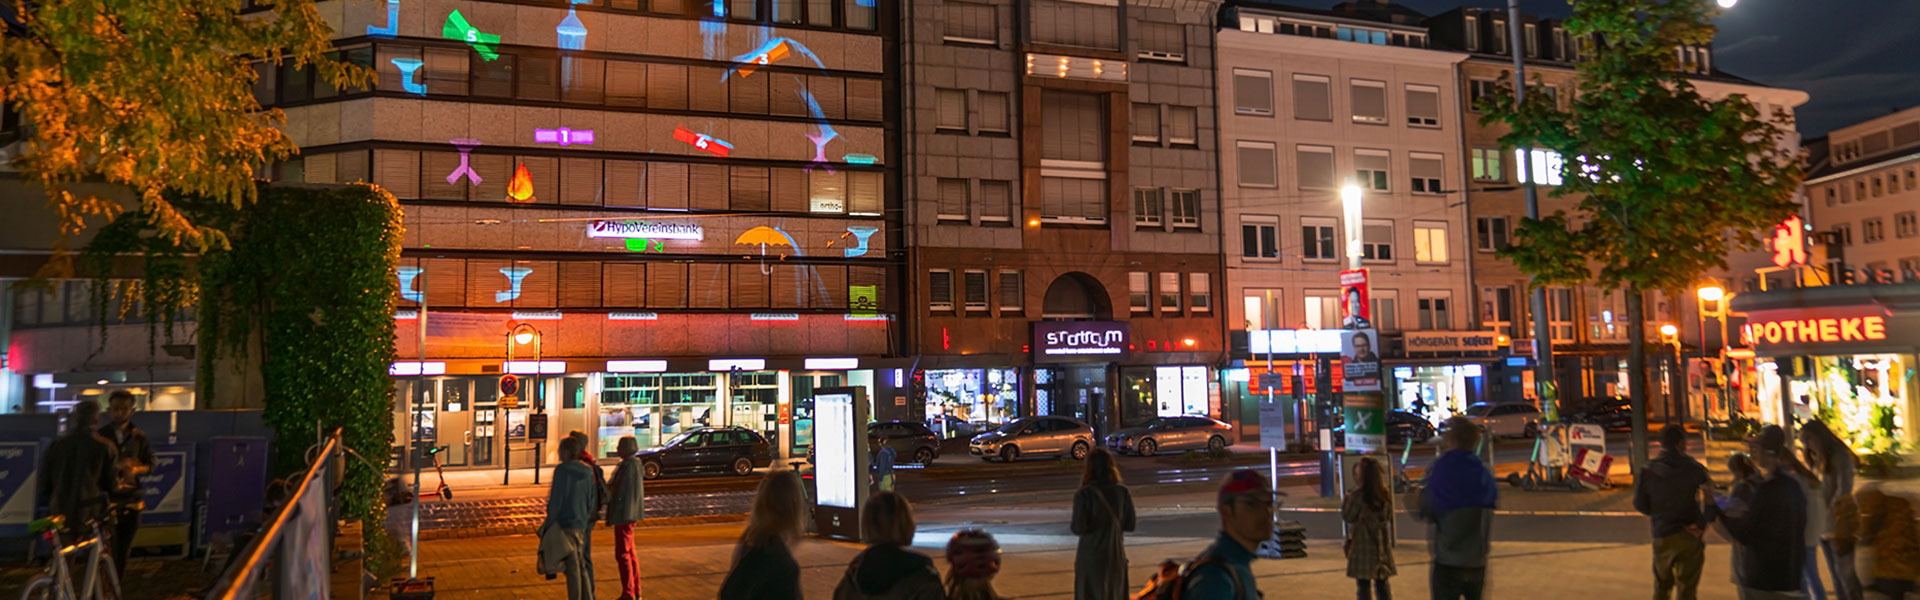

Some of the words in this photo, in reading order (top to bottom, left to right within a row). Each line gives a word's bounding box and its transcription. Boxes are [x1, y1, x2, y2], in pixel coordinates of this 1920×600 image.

[467, 29, 477, 42] 5
[560, 130, 568, 143] 1
[606, 221, 700, 234] HypoVereinsbank
[1408, 335, 1459, 347] HÖRGERÄTE
